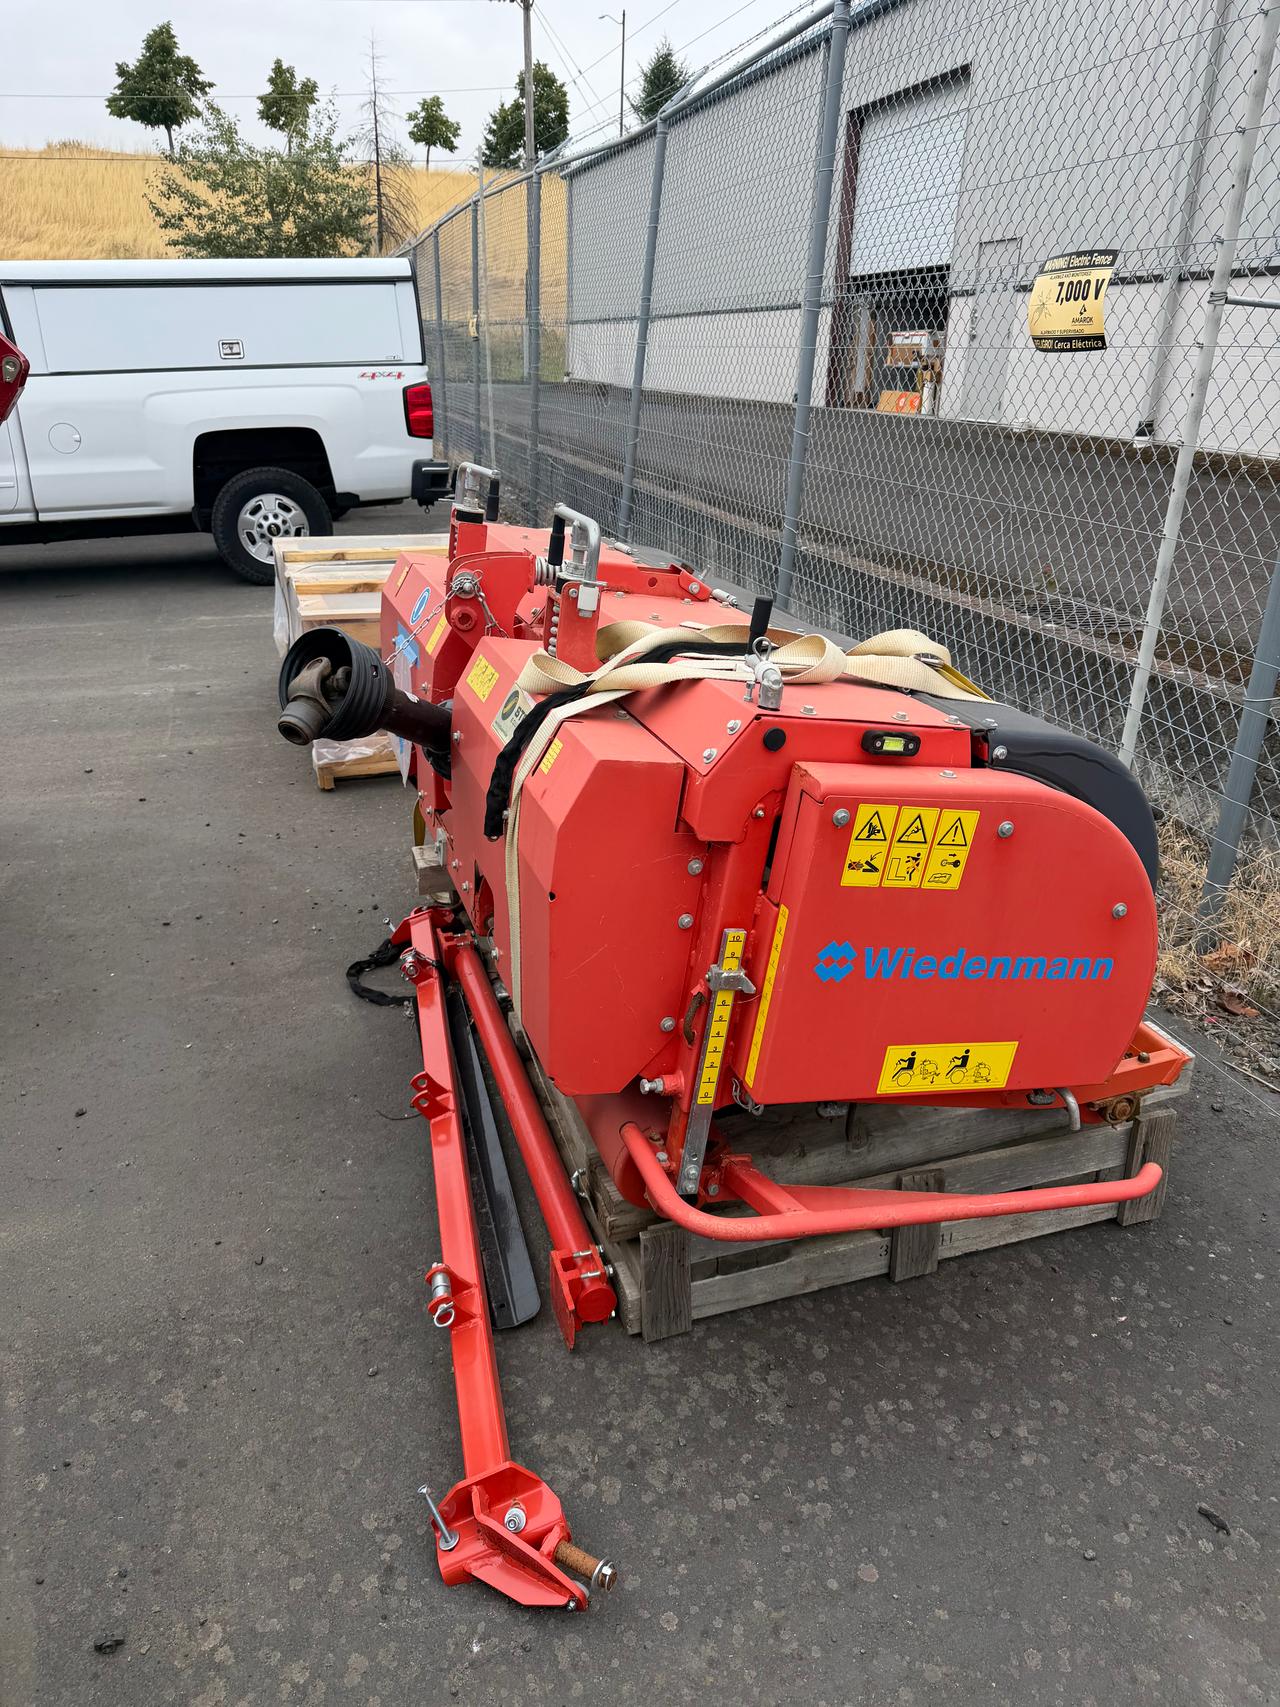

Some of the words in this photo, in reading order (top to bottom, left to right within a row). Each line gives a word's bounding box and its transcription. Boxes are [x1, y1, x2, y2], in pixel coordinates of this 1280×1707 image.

[1069, 254, 1091, 268] Electric
[1091, 253, 1113, 265] Fence
[1055, 279, 1091, 305] 7,000
[1094, 278, 1106, 300] V
[1071, 316, 1094, 324] AMAROK
[1054, 340, 1071, 349] Cerca
[1071, 338, 1103, 349] Eléctrica
[863, 946, 1114, 980] Wiedenmann
